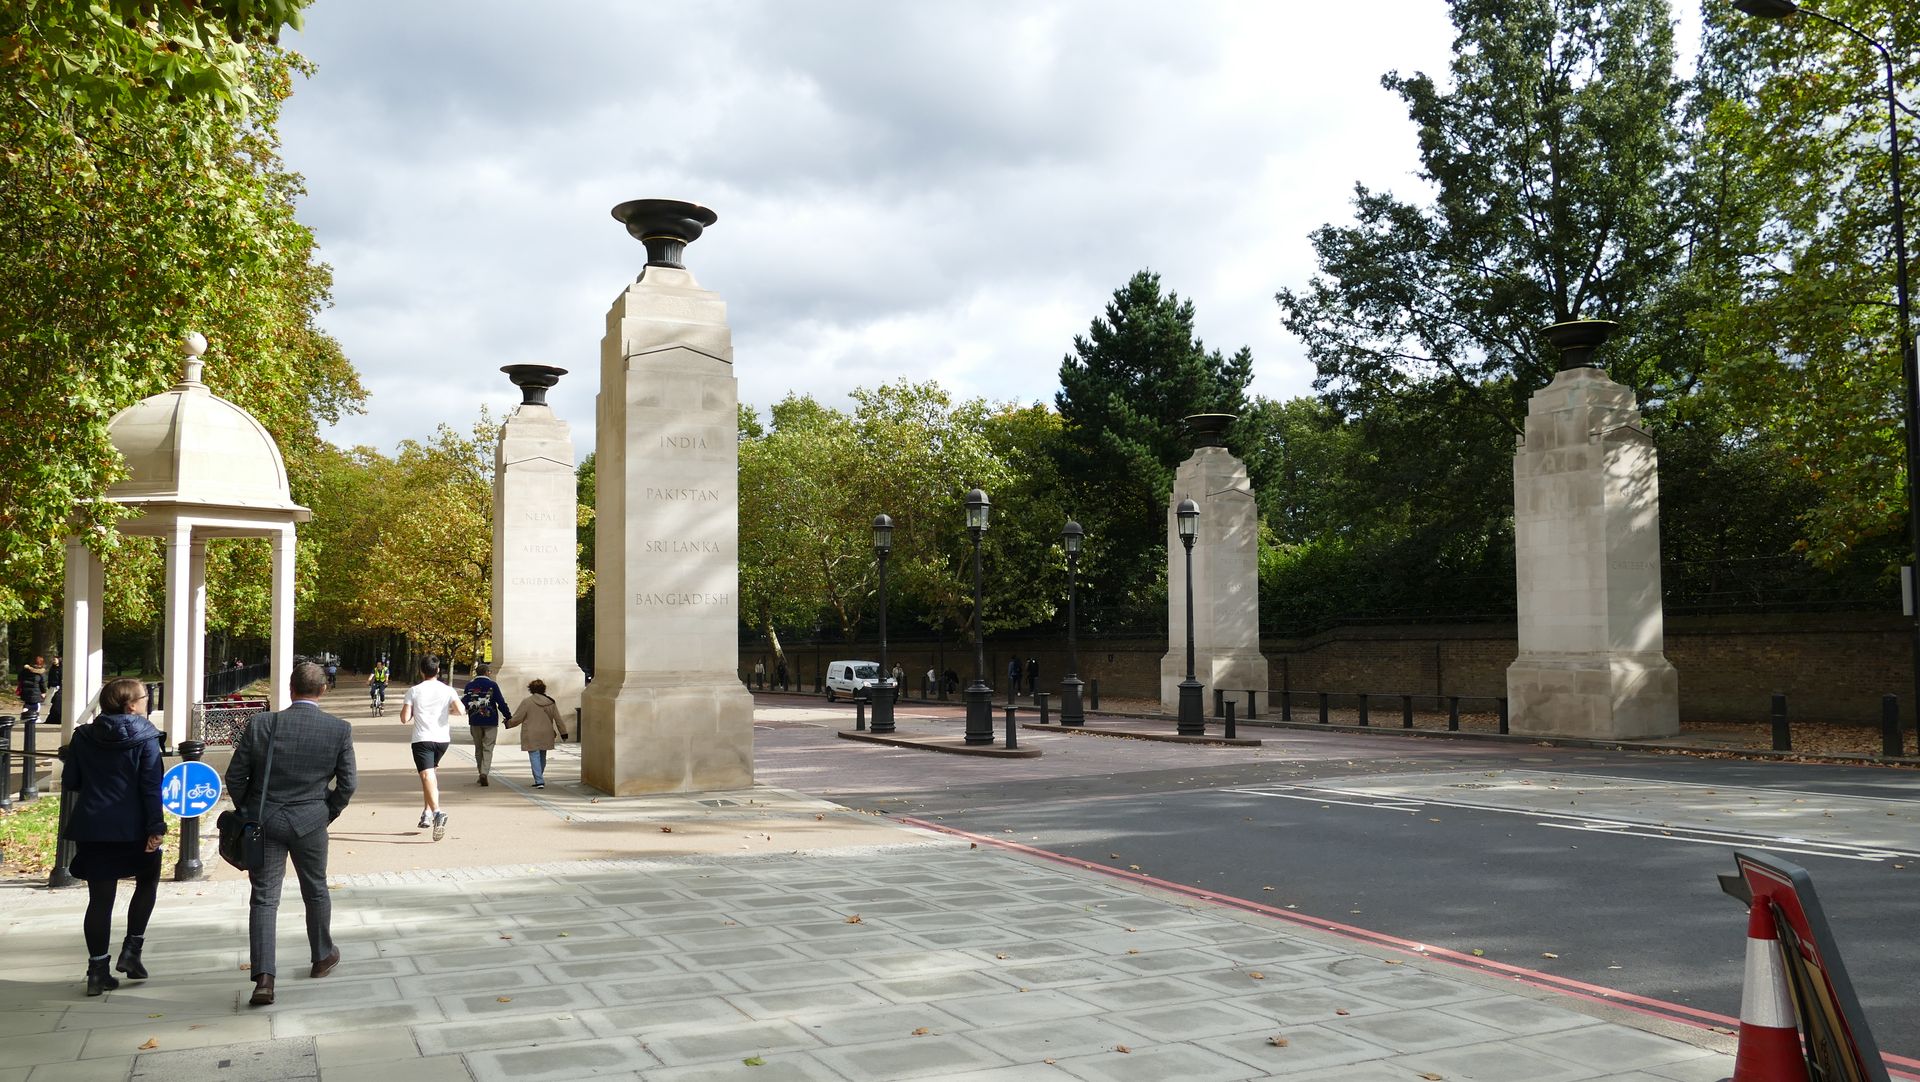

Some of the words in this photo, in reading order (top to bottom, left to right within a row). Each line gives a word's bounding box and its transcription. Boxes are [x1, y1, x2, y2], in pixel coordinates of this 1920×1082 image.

[660, 435, 707, 449] INDIA
[646, 487, 720, 502] PAKISTAN
[525, 512, 558, 521] NEPAL
[522, 545, 559, 553] AFRICA
[646, 540, 668, 553] SRI
[673, 540, 720, 553] LANKA
[512, 577, 569, 585] CARIBBEAN
[635, 593, 729, 606] BANGLADESH
